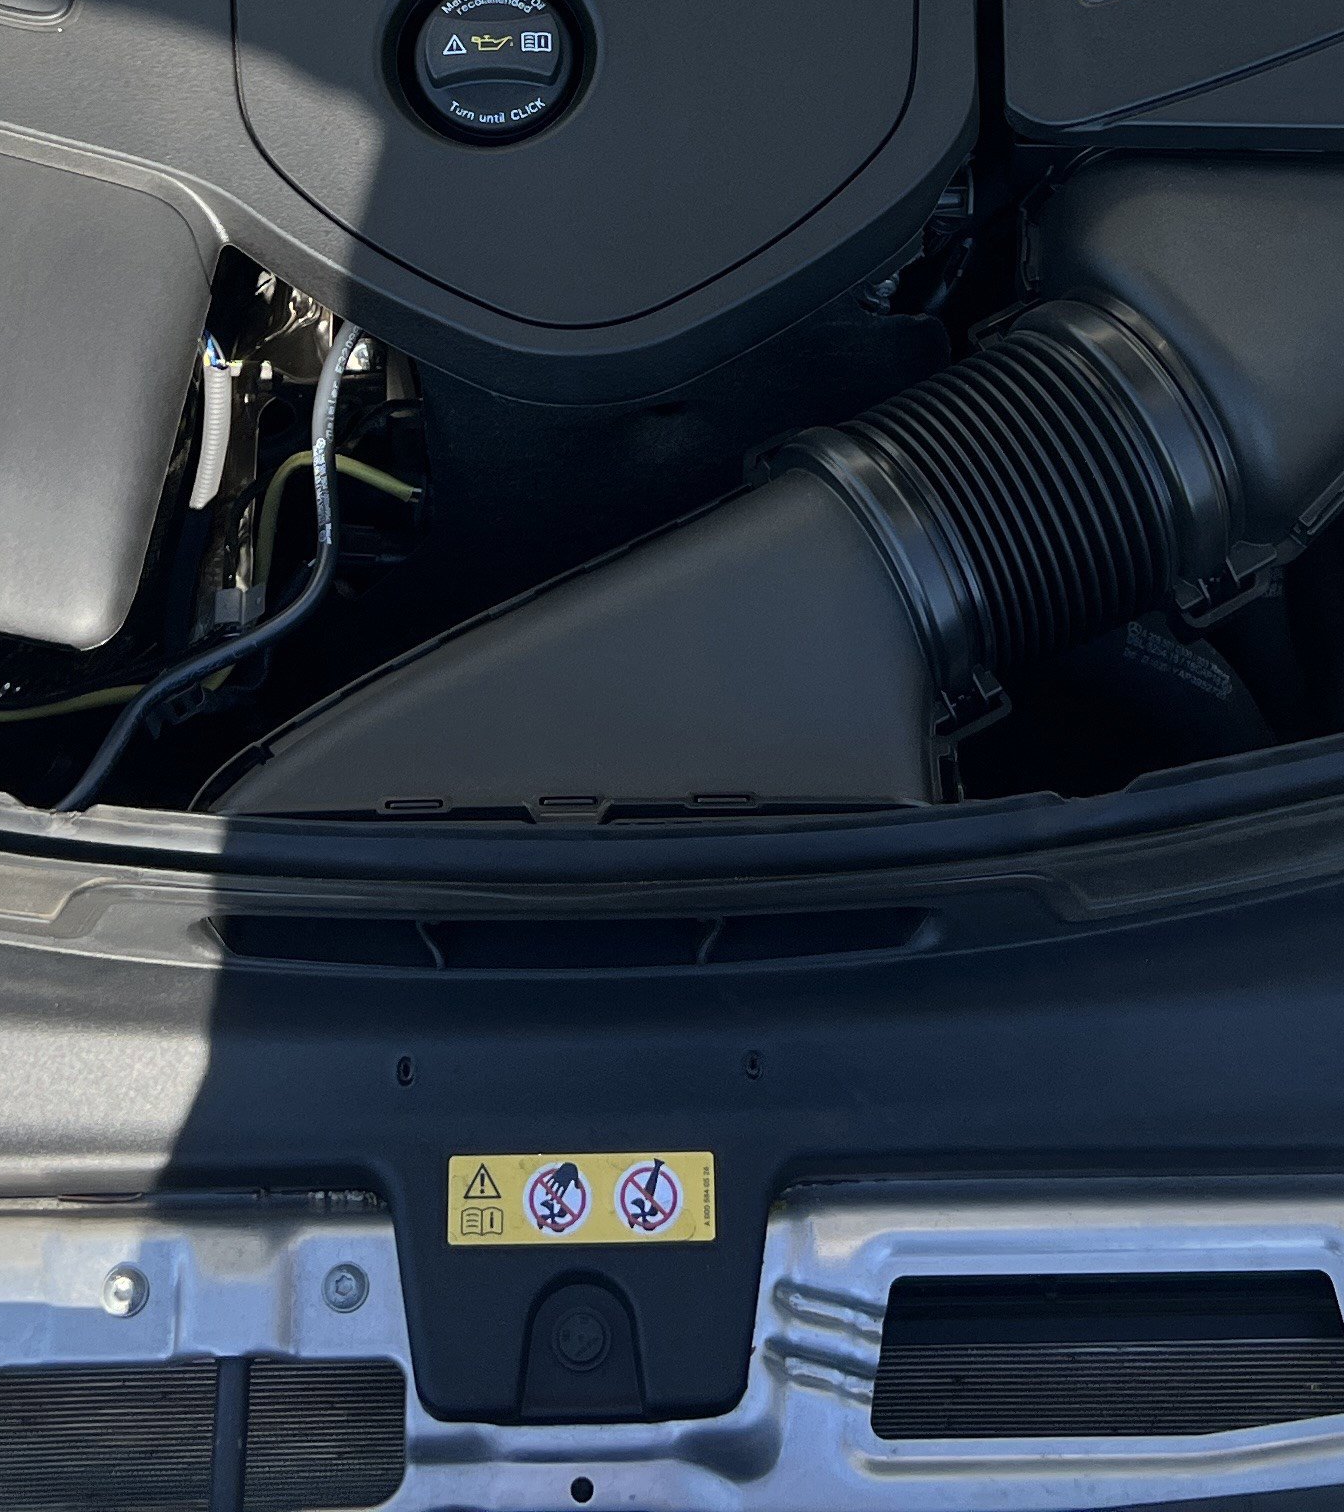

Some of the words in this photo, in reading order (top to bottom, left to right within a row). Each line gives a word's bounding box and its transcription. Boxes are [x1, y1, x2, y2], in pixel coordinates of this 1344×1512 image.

[449, 101, 475, 122] Turn
[479, 112, 506, 124] until
[510, 97, 546, 122] CLICK
